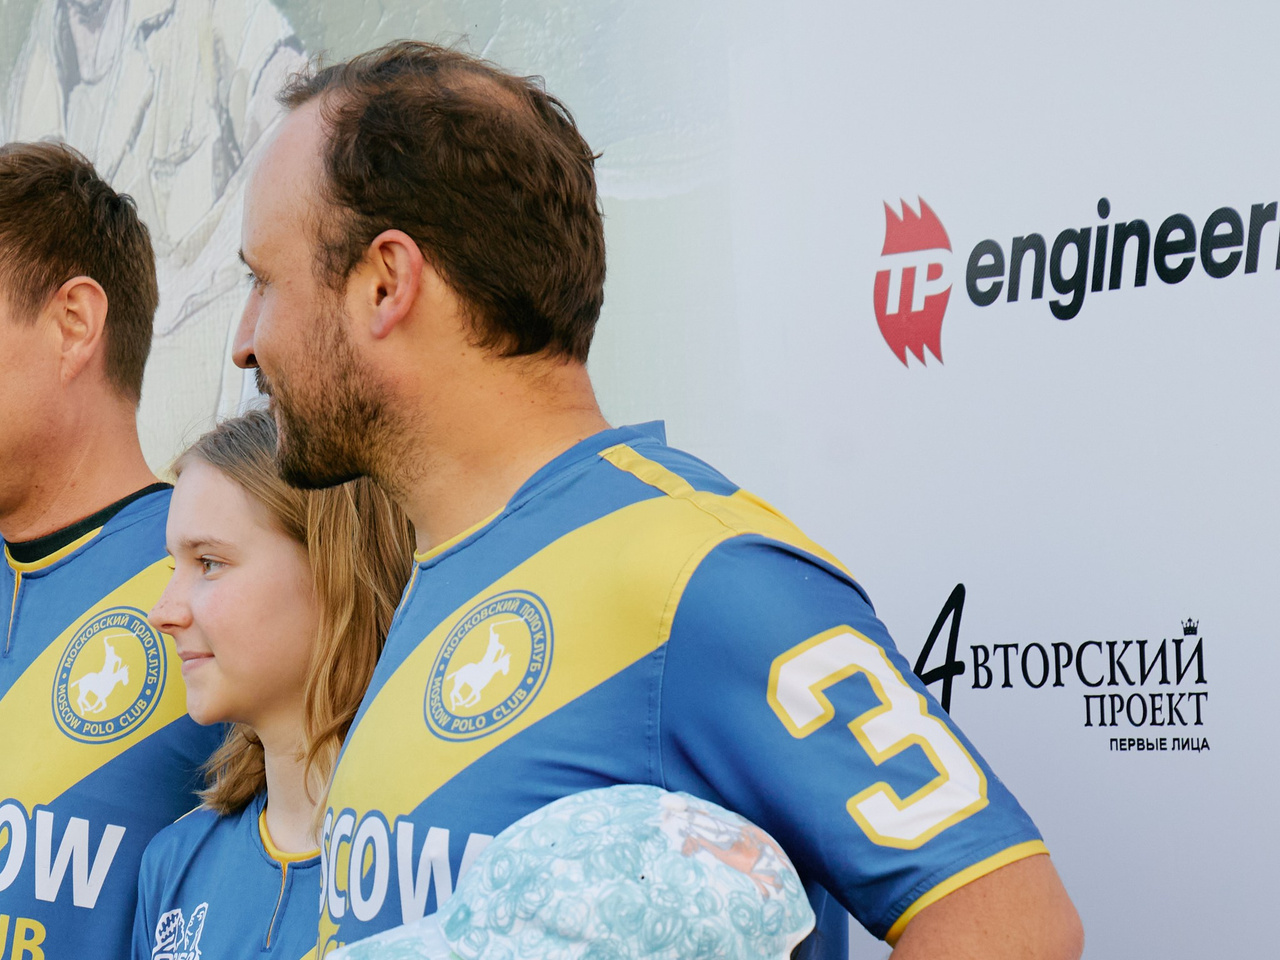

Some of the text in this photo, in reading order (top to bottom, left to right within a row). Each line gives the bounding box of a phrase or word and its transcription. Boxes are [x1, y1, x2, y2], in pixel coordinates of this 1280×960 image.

[965, 196, 1280, 321] engineer
[64, 614, 159, 685] МОСКОВСКИЙ ПОЛО КЛУБ
[443, 598, 545, 673] МОСКОВСКИЙ ПОЛО КЛУБ
[913, 583, 1208, 715] АВТОРСКИЙ
[58, 683, 148, 735] MOSCOW POLO CLUB
[430, 676, 528, 732] MOSCOW POLO CLUB
[767, 624, 989, 850] 3
[1083, 691, 1209, 728] ПРОЕКТ
[1109, 737, 1210, 754] ПЕРВЫЕ ЛИЦА
[319, 812, 495, 926] SCOW
